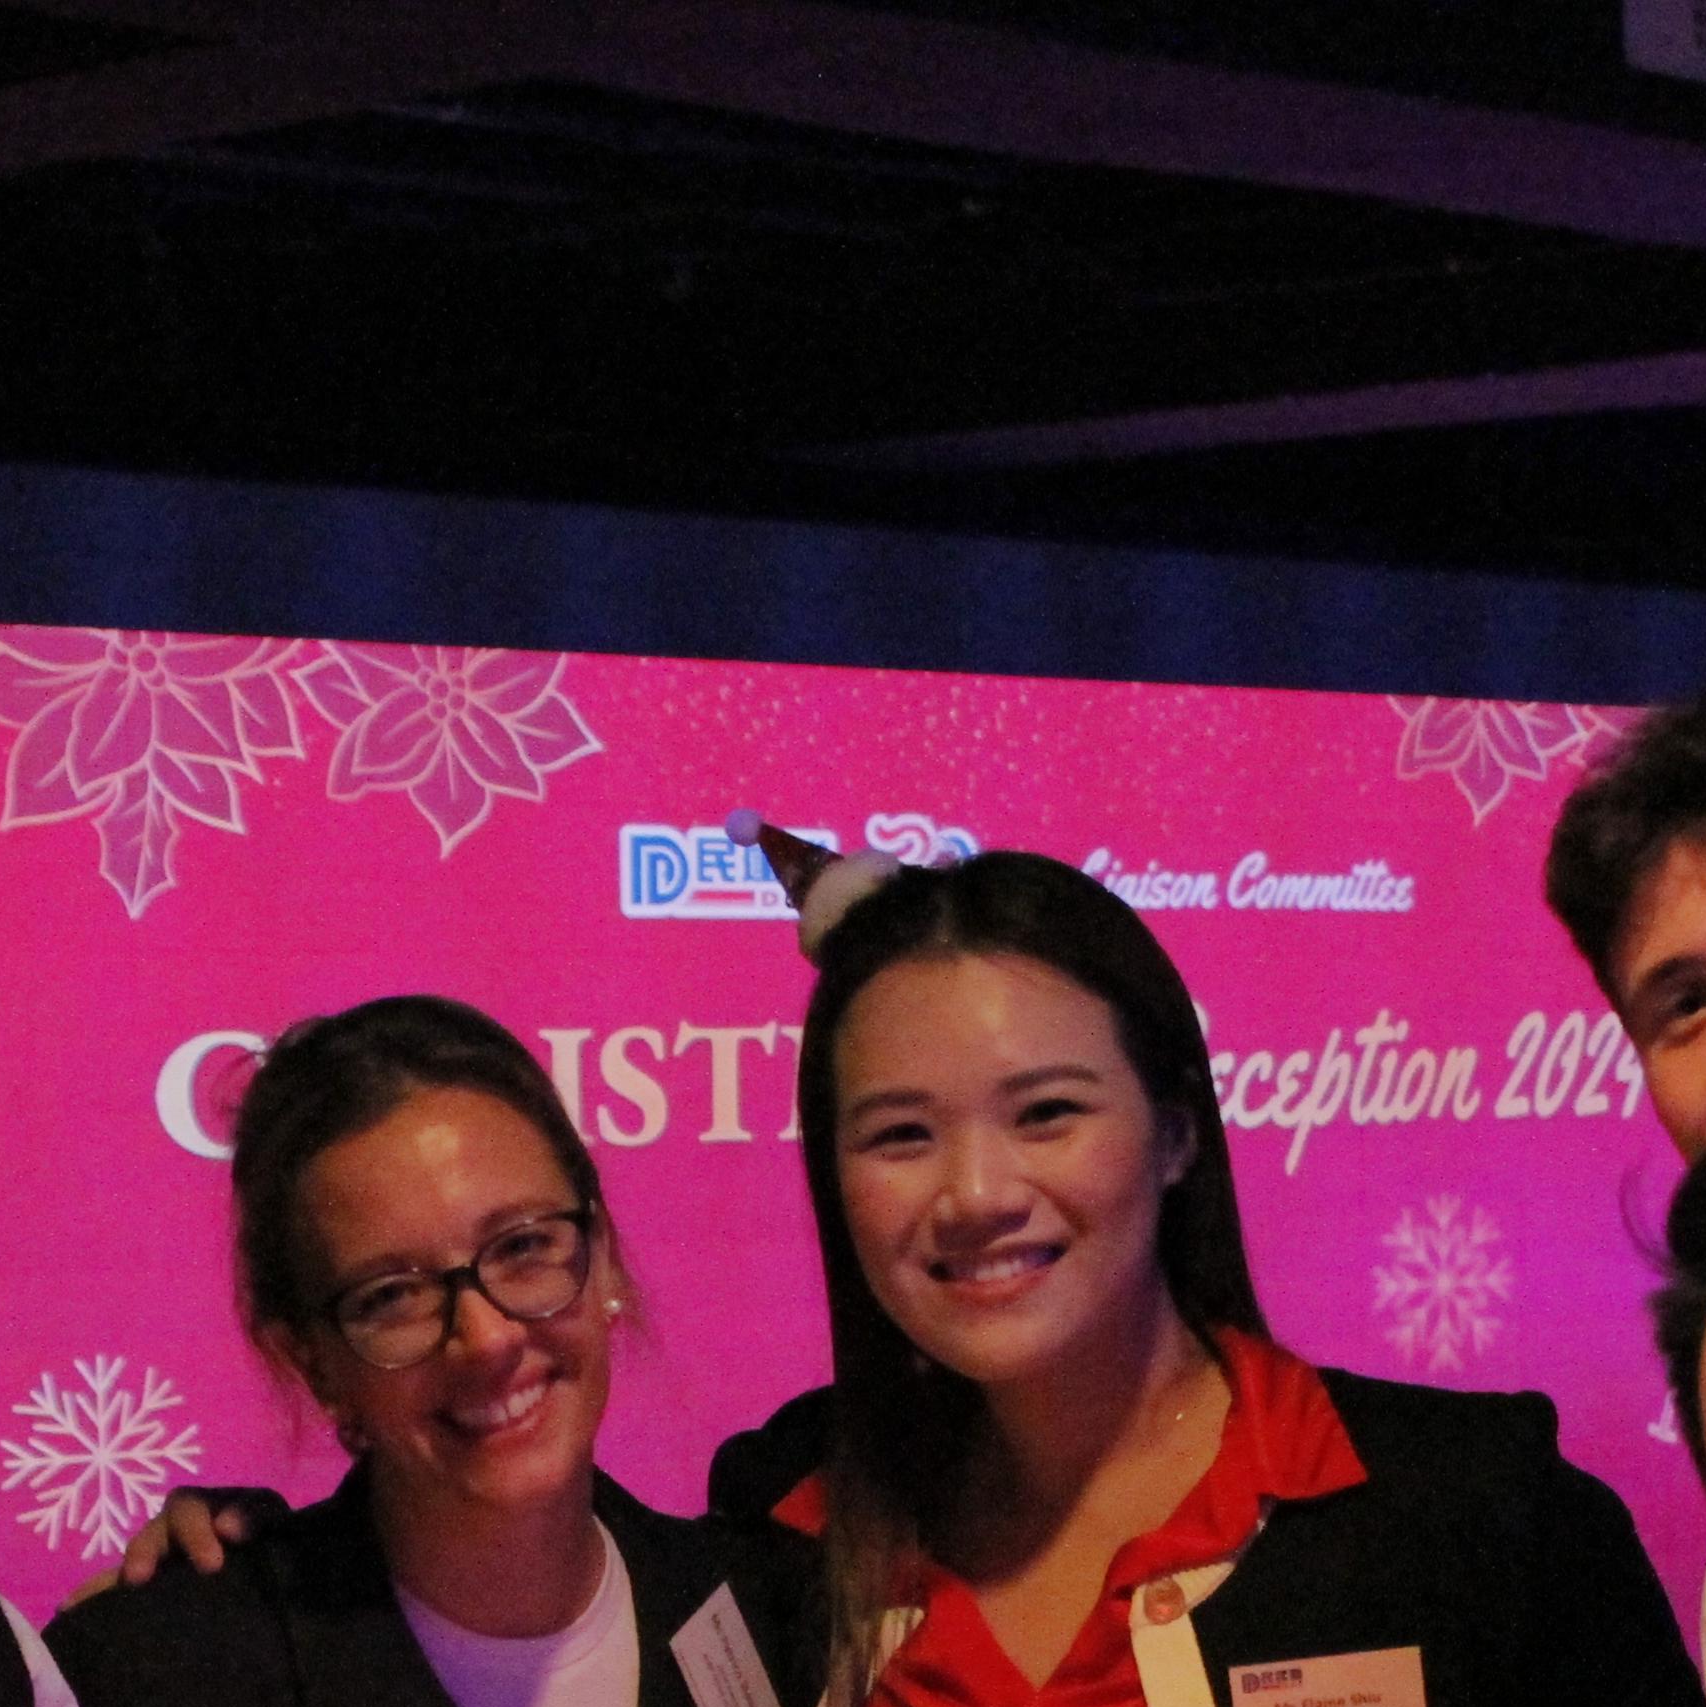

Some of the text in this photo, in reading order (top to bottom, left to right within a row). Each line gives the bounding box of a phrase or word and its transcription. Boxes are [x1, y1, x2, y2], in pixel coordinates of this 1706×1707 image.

[1227, 850, 1414, 912] Committee
[1195, 1003, 1481, 1176] eception
[1494, 1010, 1644, 1119] 2024
